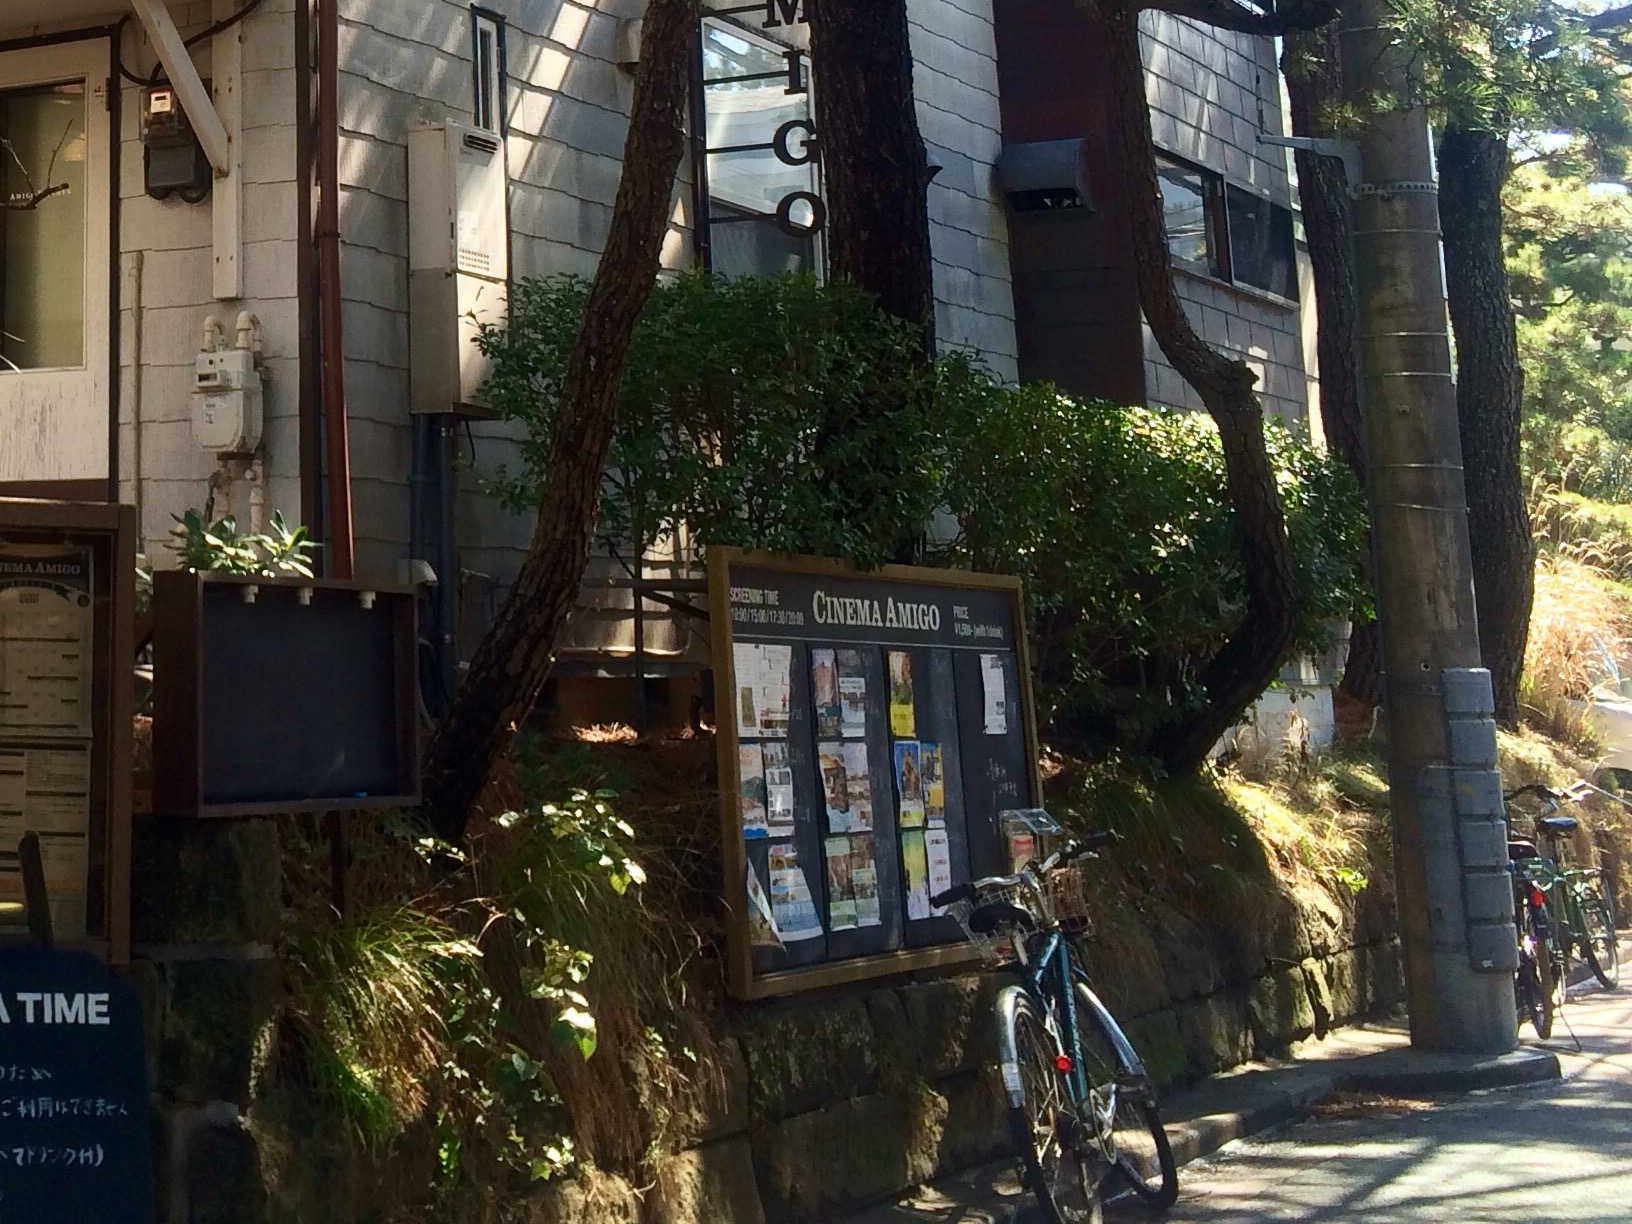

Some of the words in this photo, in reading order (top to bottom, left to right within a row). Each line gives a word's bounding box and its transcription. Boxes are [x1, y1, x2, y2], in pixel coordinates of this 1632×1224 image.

[35, 561, 81, 575] AMIGO
[812, 590, 884, 627] CINEMA
[885, 596, 941, 631] AMIGO
[17, 992, 111, 1025] TIME
